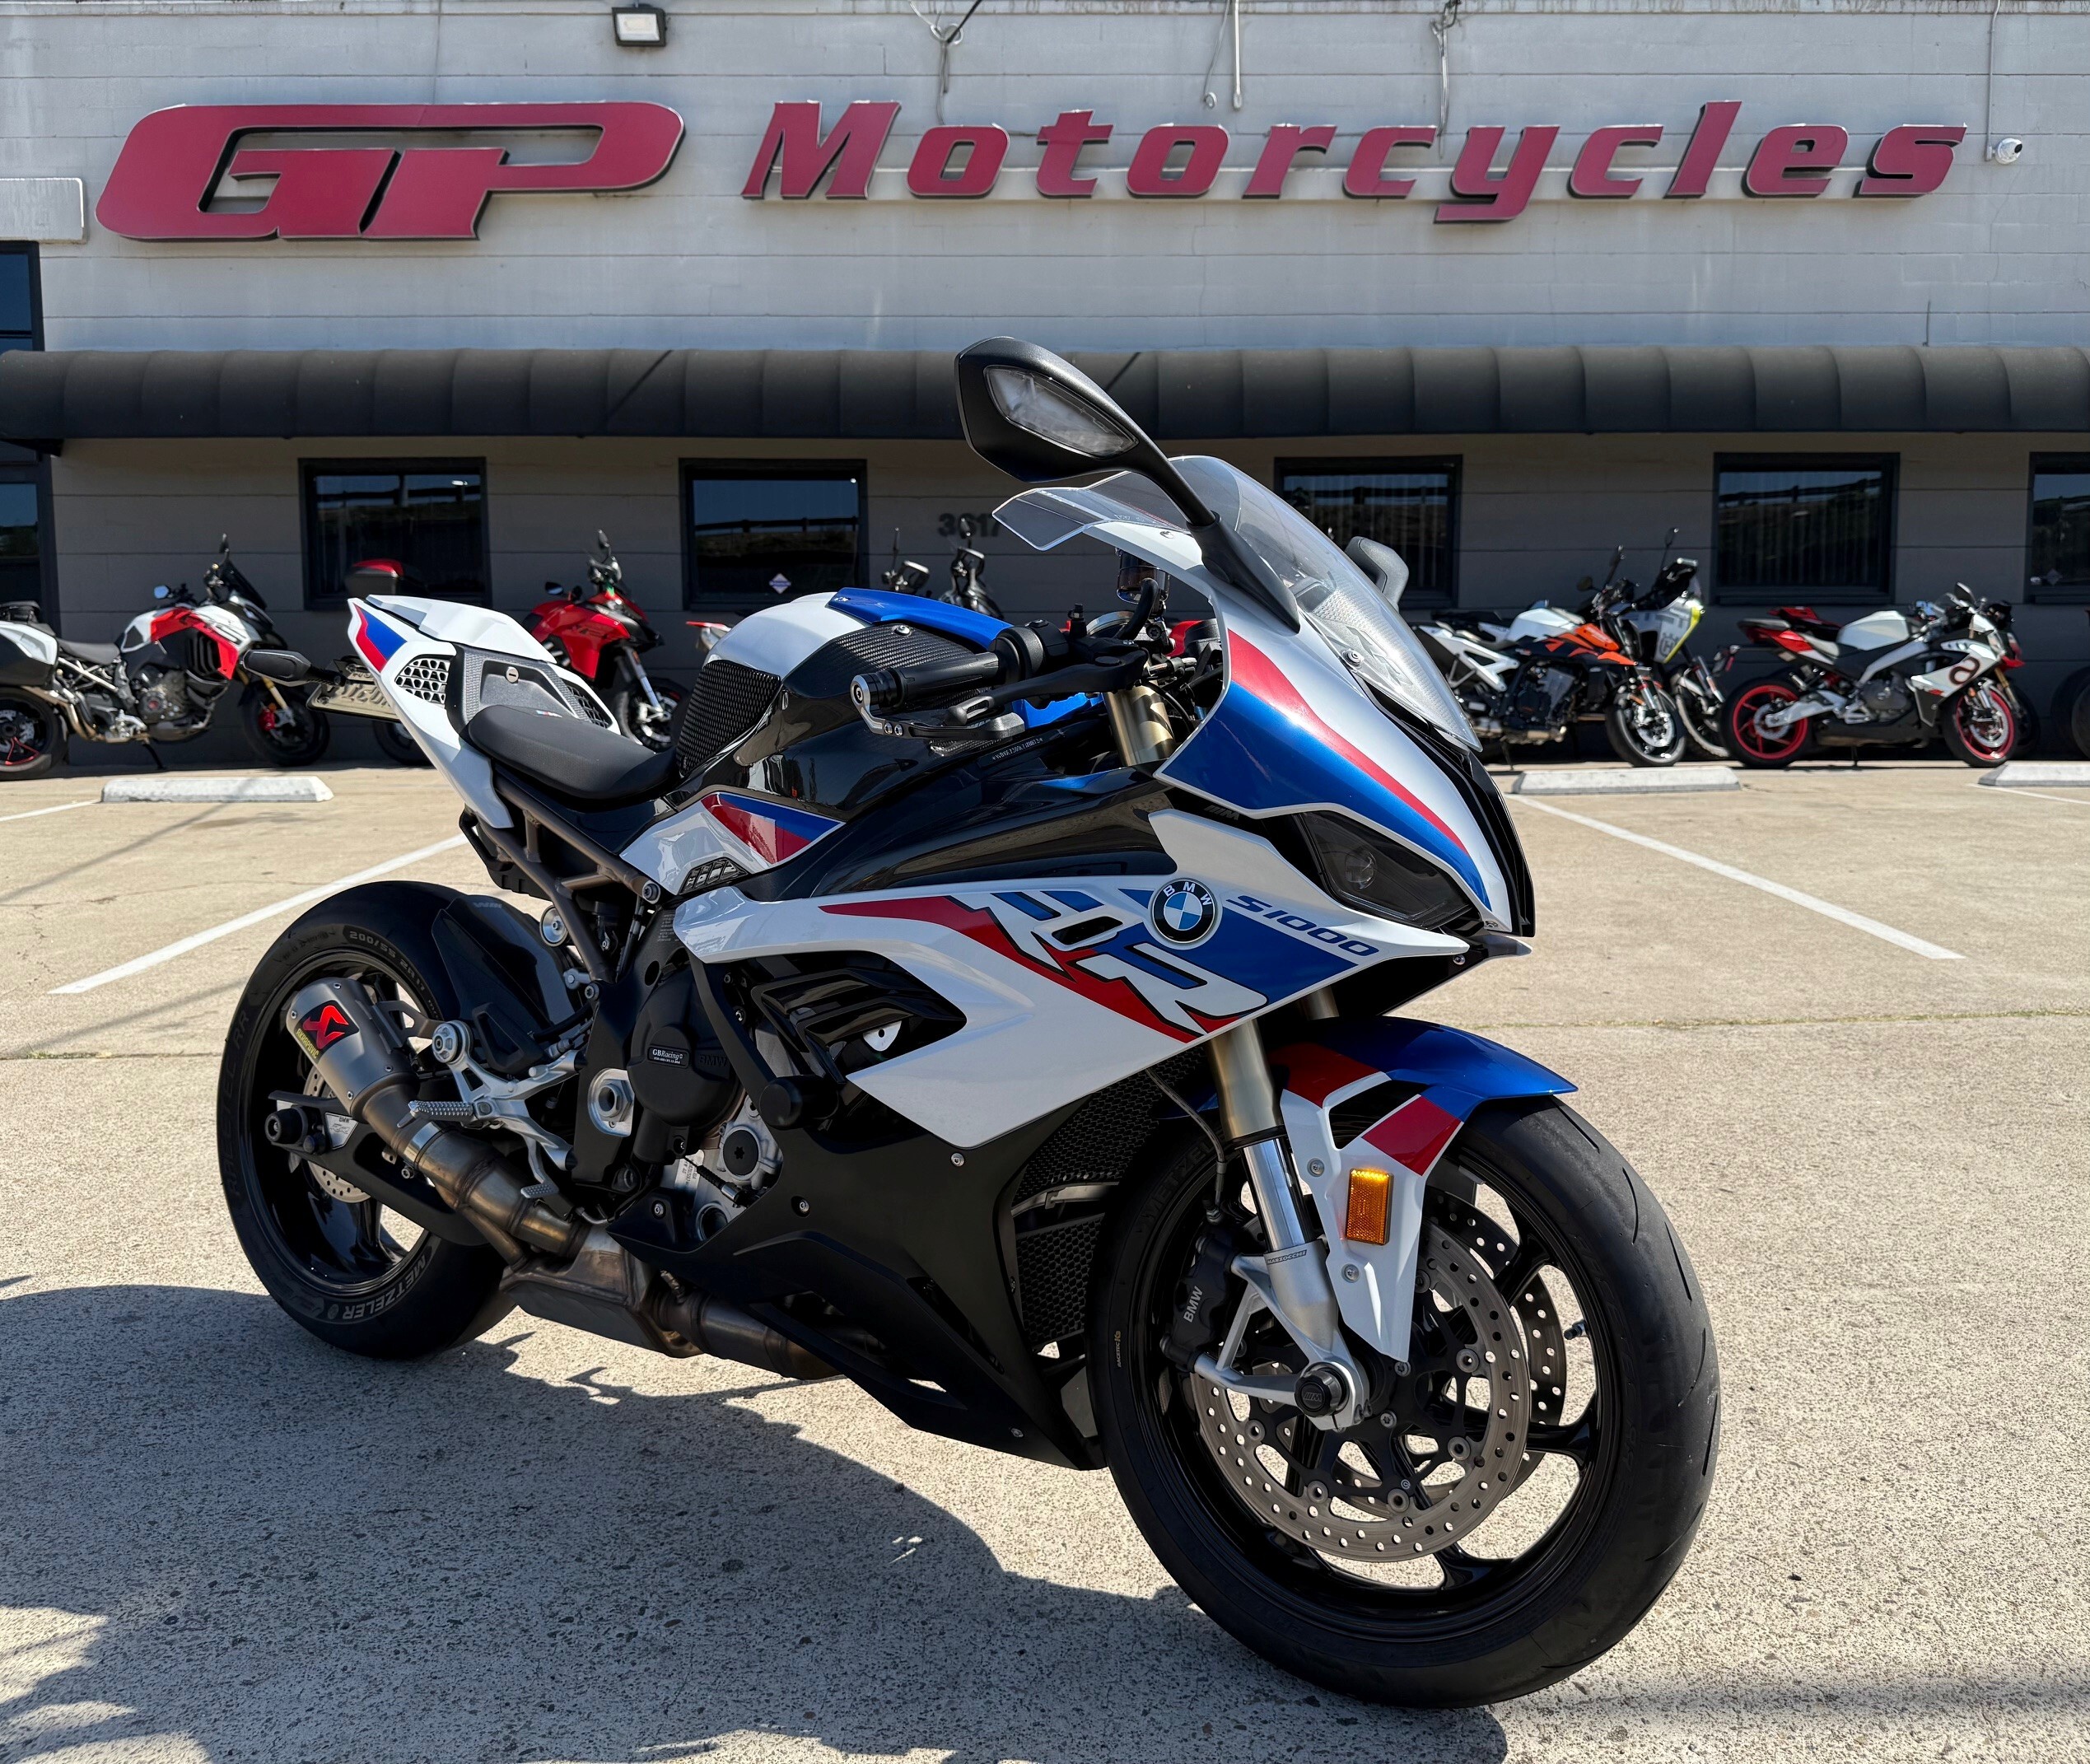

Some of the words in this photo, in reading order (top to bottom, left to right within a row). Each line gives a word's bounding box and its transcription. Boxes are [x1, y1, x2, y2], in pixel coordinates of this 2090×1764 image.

[96, 101, 685, 240] GP
[741, 100, 1967, 223] Motorcycles
[1163, 881, 1212, 906] BMW
[1225, 895, 1380, 957] S1000
[349, 931, 396, 959] 200/55
[1267, 1249, 1307, 1265] MARZOCCHI
[342, 1254, 427, 1319] METZELER
[1183, 1286, 1203, 1323] BMW
